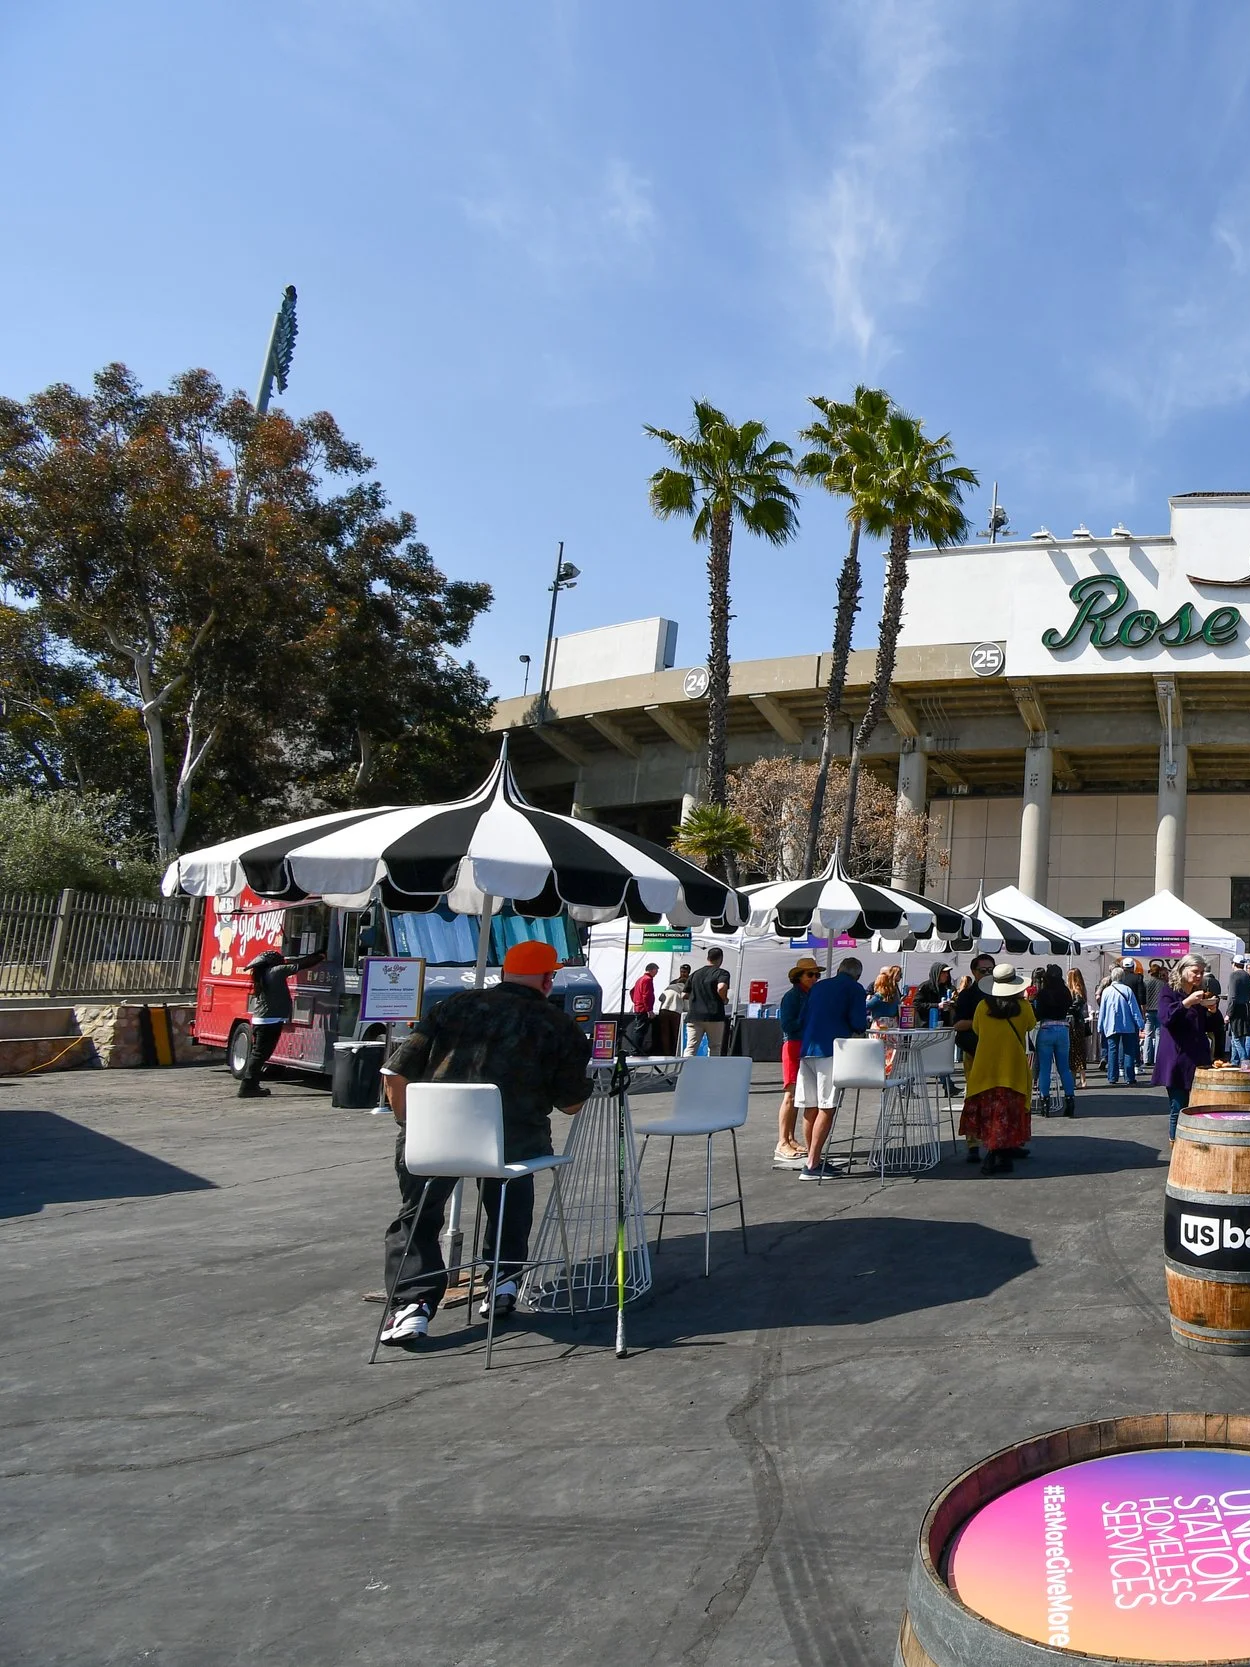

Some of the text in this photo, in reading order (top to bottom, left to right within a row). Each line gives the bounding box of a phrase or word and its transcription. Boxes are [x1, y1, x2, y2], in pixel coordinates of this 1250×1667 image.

[1042, 573, 1241, 650] Rose
[686, 674, 706, 692] 24
[974, 650, 999, 668] 25
[1184, 1222, 1215, 1246] us
[1043, 1484, 1075, 1647] #EatMoreGiveMore
[1101, 1501, 1158, 1610] SERVICES
[1139, 1497, 1197, 1606] HOMELESS
[1173, 1494, 1250, 1603] STATION
